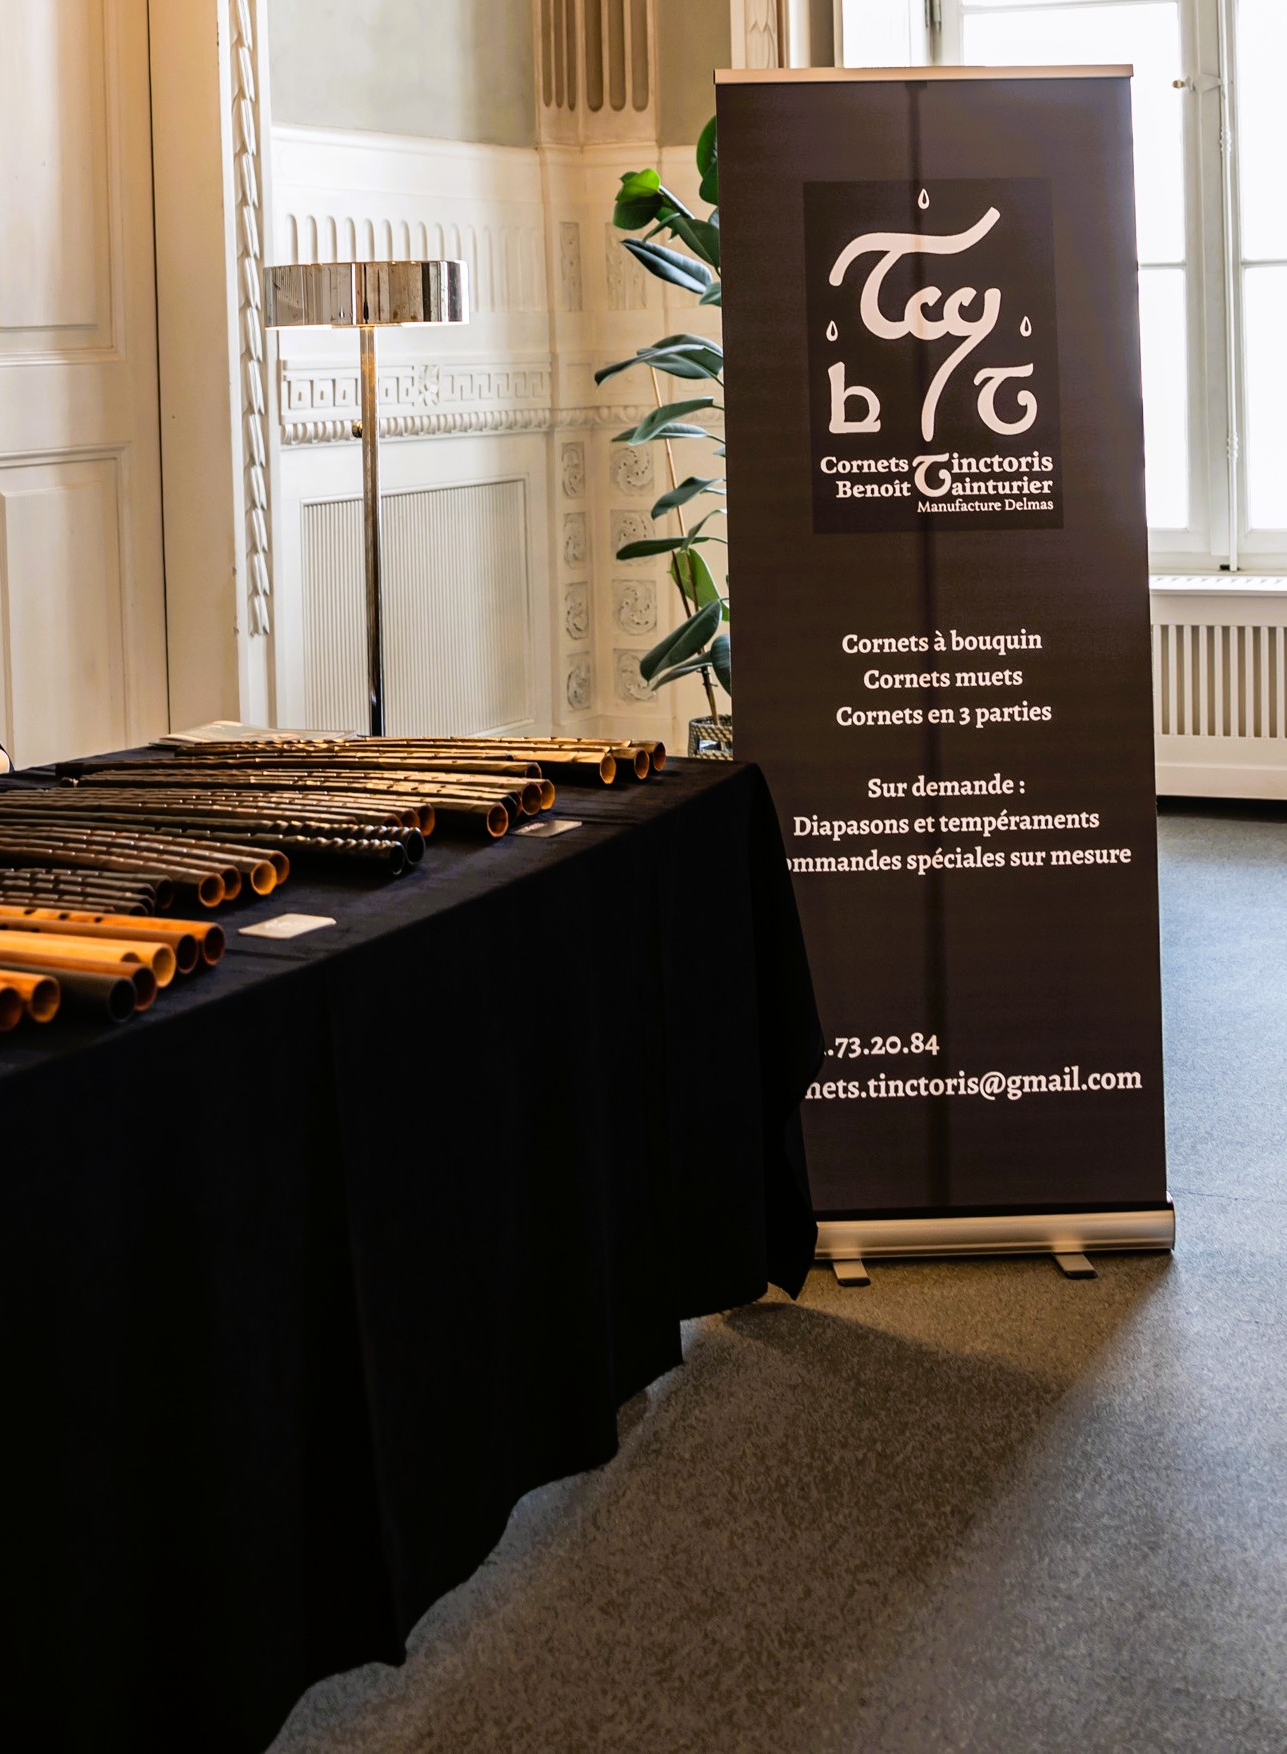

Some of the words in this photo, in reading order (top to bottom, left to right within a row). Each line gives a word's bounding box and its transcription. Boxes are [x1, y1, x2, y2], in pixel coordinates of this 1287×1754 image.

[820, 456, 909, 474] Cornets
[835, 479, 912, 498] Benoît
[917, 498, 1002, 513] Manufacture
[1004, 497, 1054, 511] Delmas
[841, 634, 929, 654] Cornets
[933, 629, 947, 652] à
[949, 628, 1043, 656] bouquin
[863, 669, 951, 690] Cornets
[954, 669, 1023, 687] muets
[836, 706, 924, 727] Cornets
[927, 708, 956, 724] en
[958, 707, 971, 726] 3
[974, 700, 1052, 729] parties
[867, 778, 908, 799] Sur
[911, 772, 1015, 797] demande
[793, 814, 910, 842] Diapasons
[913, 816, 936, 834] et
[938, 808, 1100, 838] tempéraments
[906, 845, 1006, 876] spéciales
[1010, 851, 1046, 867] sur
[1049, 848, 1132, 866] mesure
